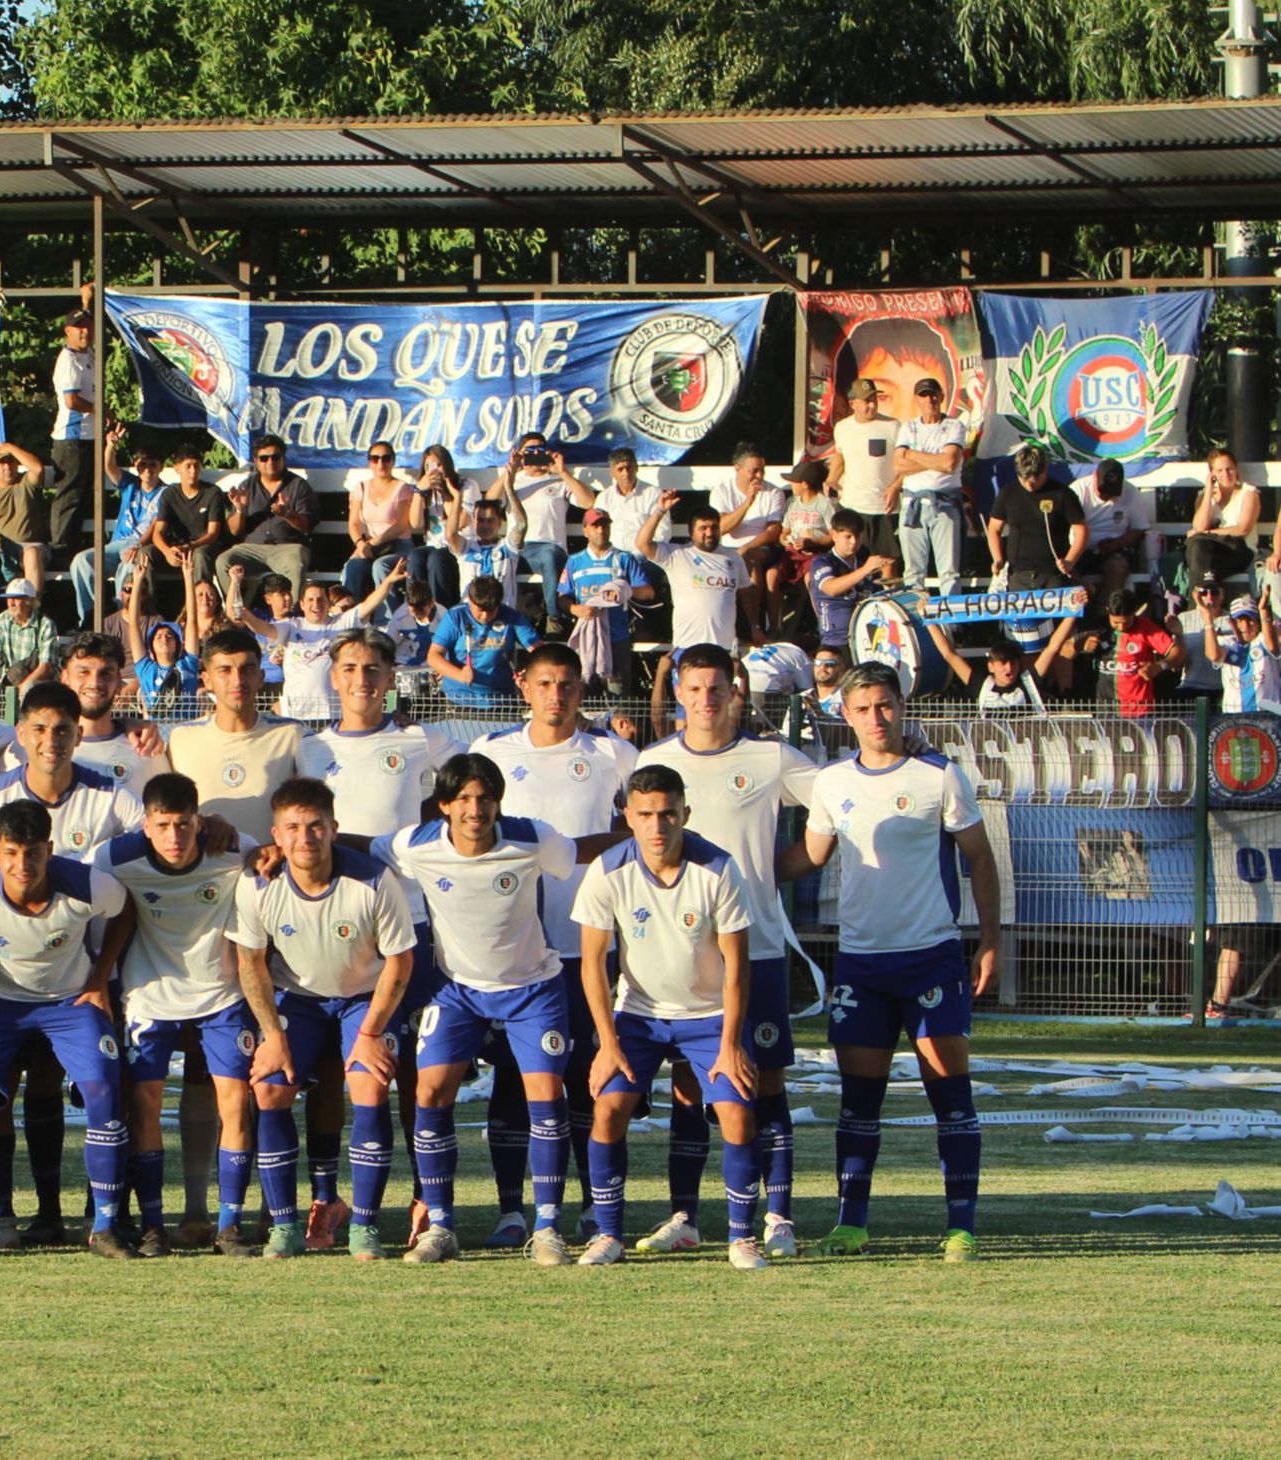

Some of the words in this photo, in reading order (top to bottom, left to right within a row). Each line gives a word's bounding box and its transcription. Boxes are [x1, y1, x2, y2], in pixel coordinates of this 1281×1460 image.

[256, 321, 384, 381] LOS
[393, 319, 508, 396] QUE
[512, 319, 579, 378] SE
[624, 327, 654, 358] CLUB
[653, 319, 674, 333] DE
[1079, 371, 1145, 408] USC
[237, 385, 471, 452] MANDAN
[638, 413, 682, 439] SANTA
[632, 926, 646, 938] 24
